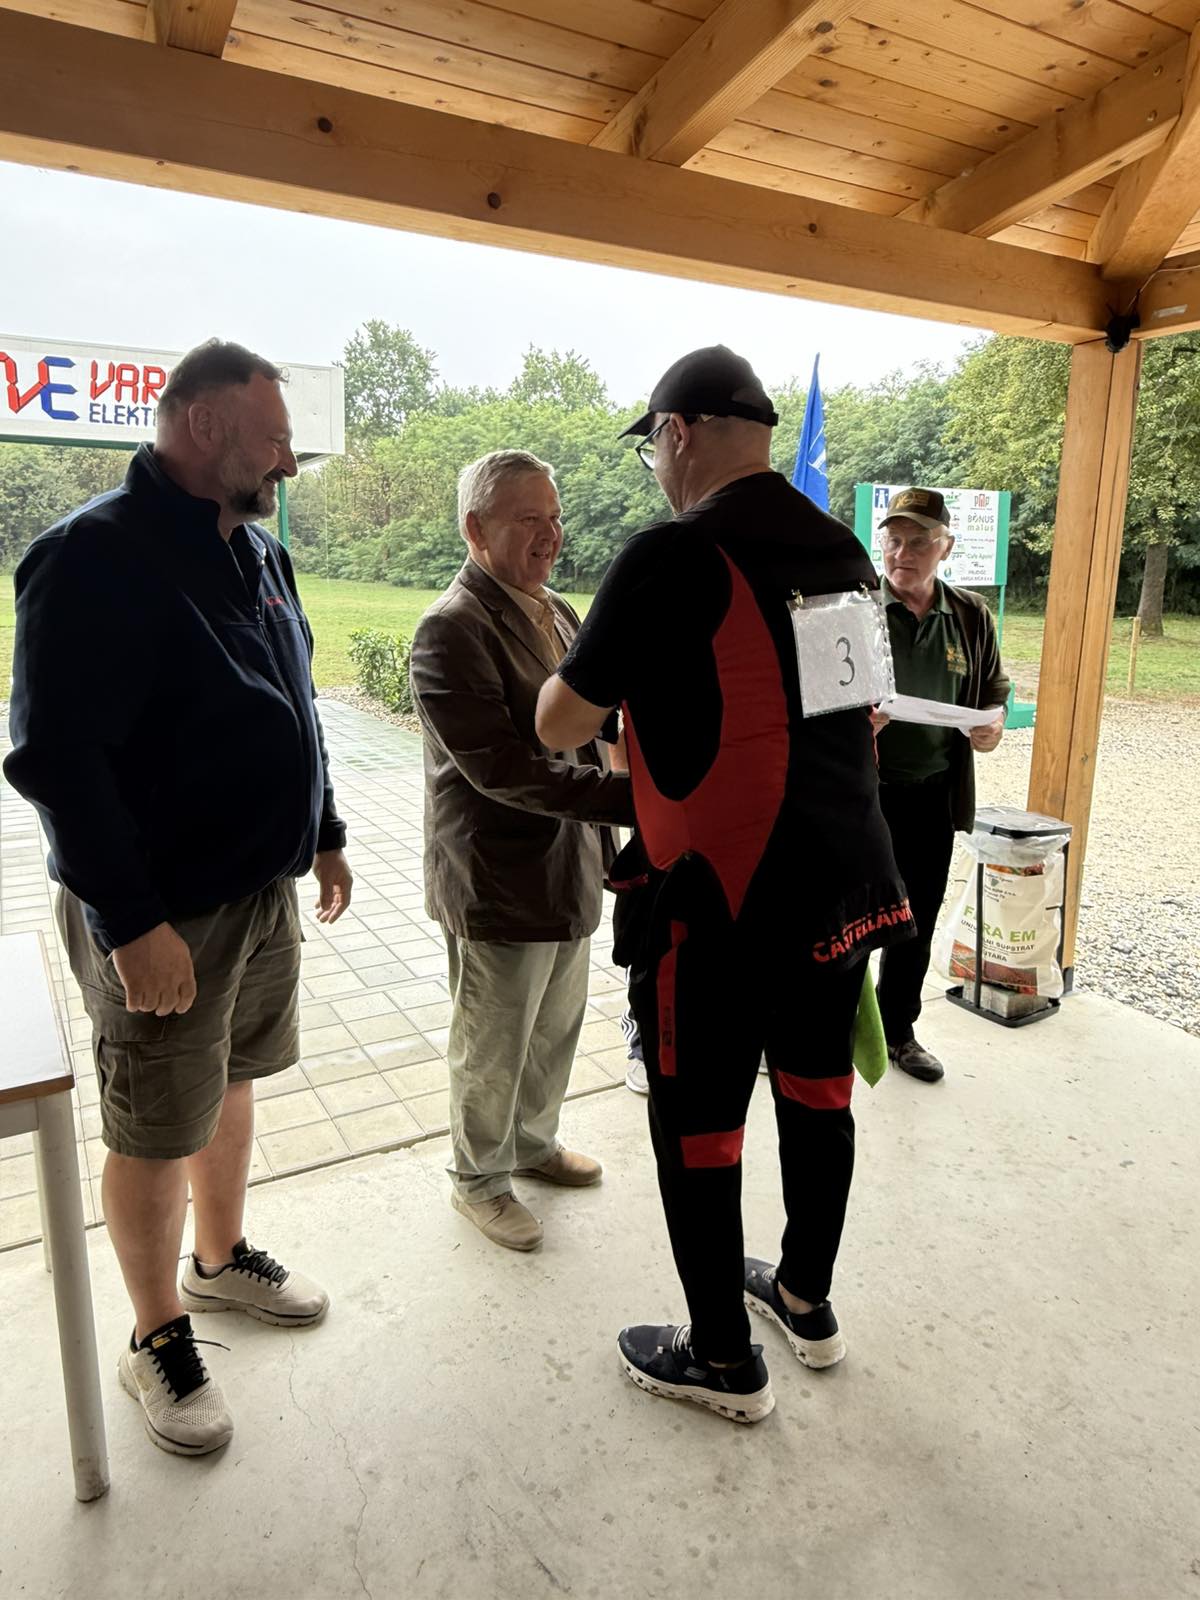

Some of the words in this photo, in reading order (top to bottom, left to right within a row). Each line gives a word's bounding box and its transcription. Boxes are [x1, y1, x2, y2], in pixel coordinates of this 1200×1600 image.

[90, 360, 170, 405] VAR
[89, 402, 157, 427] ELEKT
[835, 636, 855, 687] 3
[1009, 929, 1036, 943] EM
